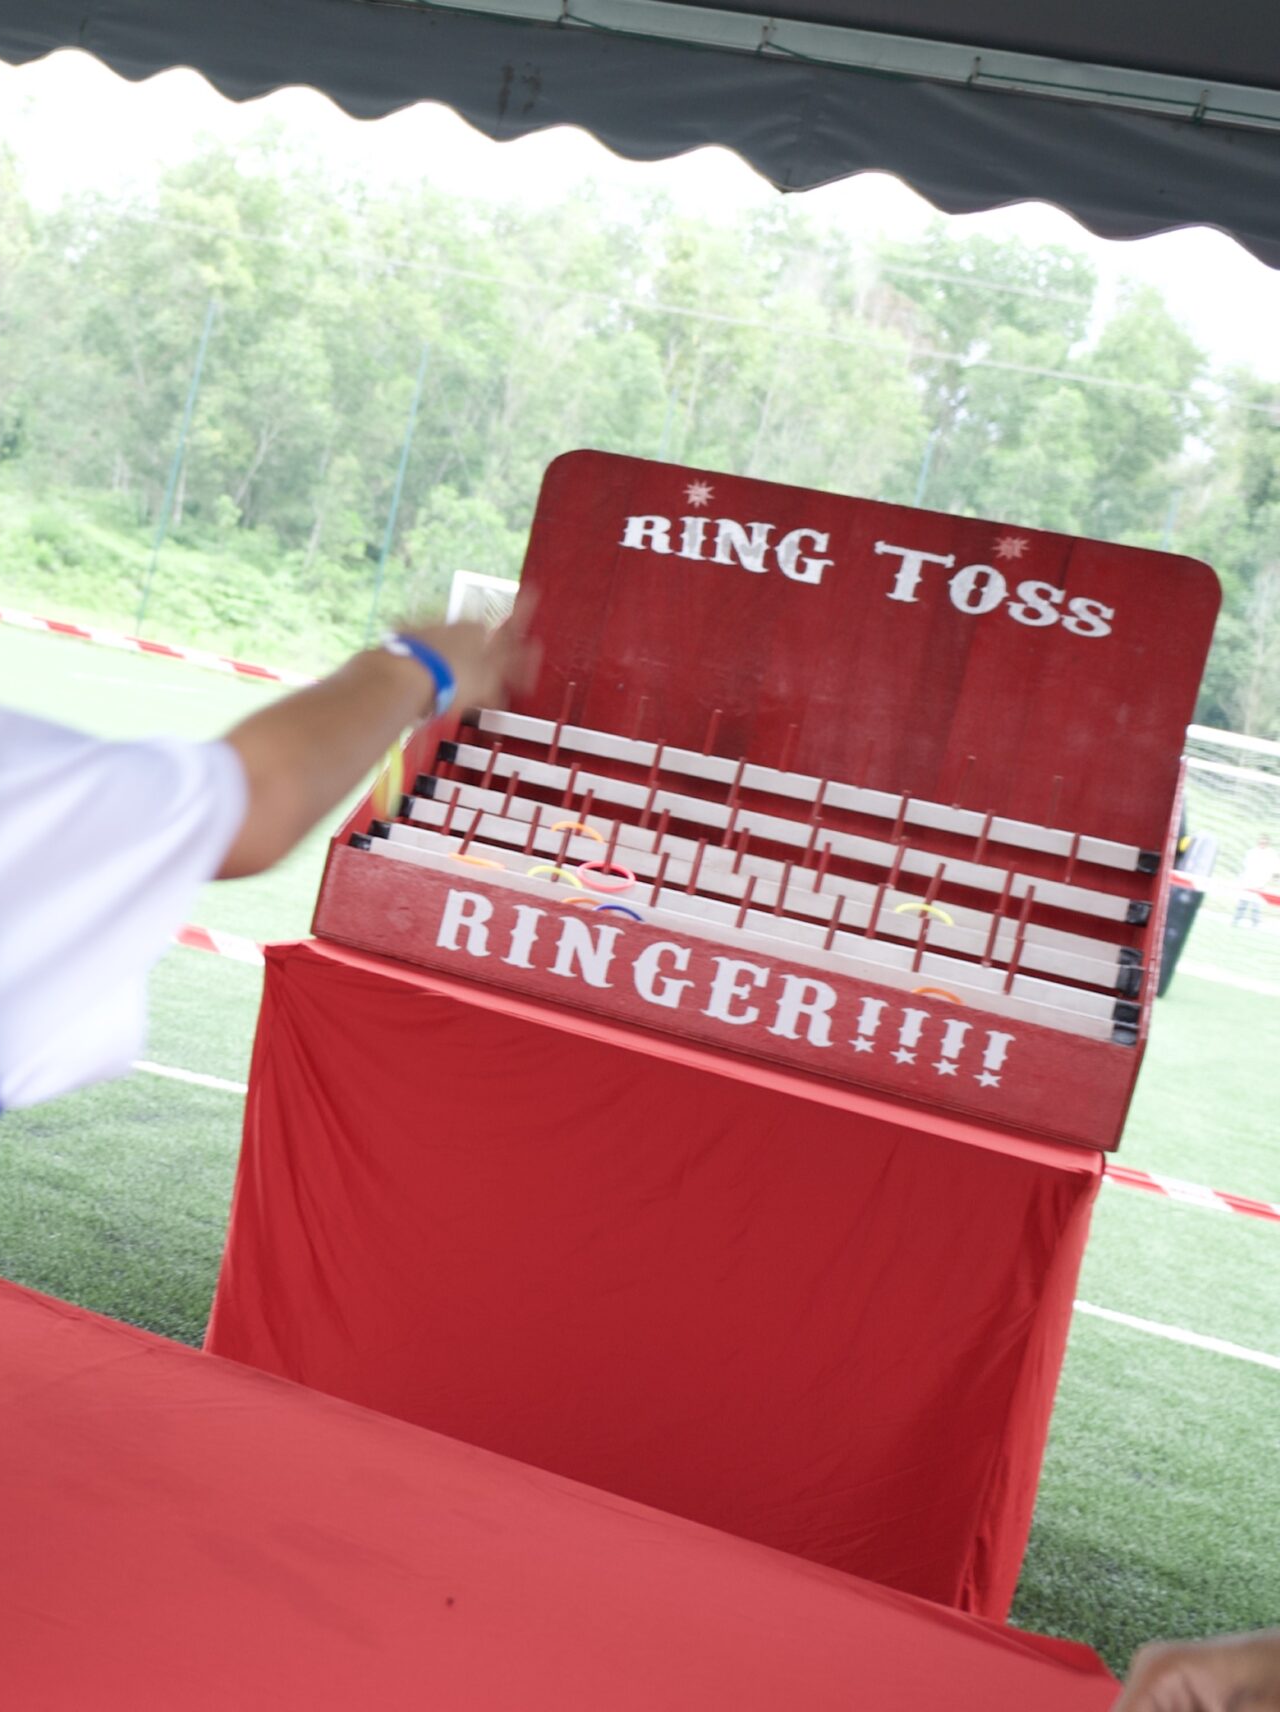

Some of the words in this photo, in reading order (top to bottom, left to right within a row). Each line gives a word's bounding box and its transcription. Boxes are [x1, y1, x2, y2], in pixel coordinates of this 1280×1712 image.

[619, 514, 834, 585] RING
[874, 540, 1115, 638] TOSS
[436, 888, 1015, 1088] RINGER!!!!
